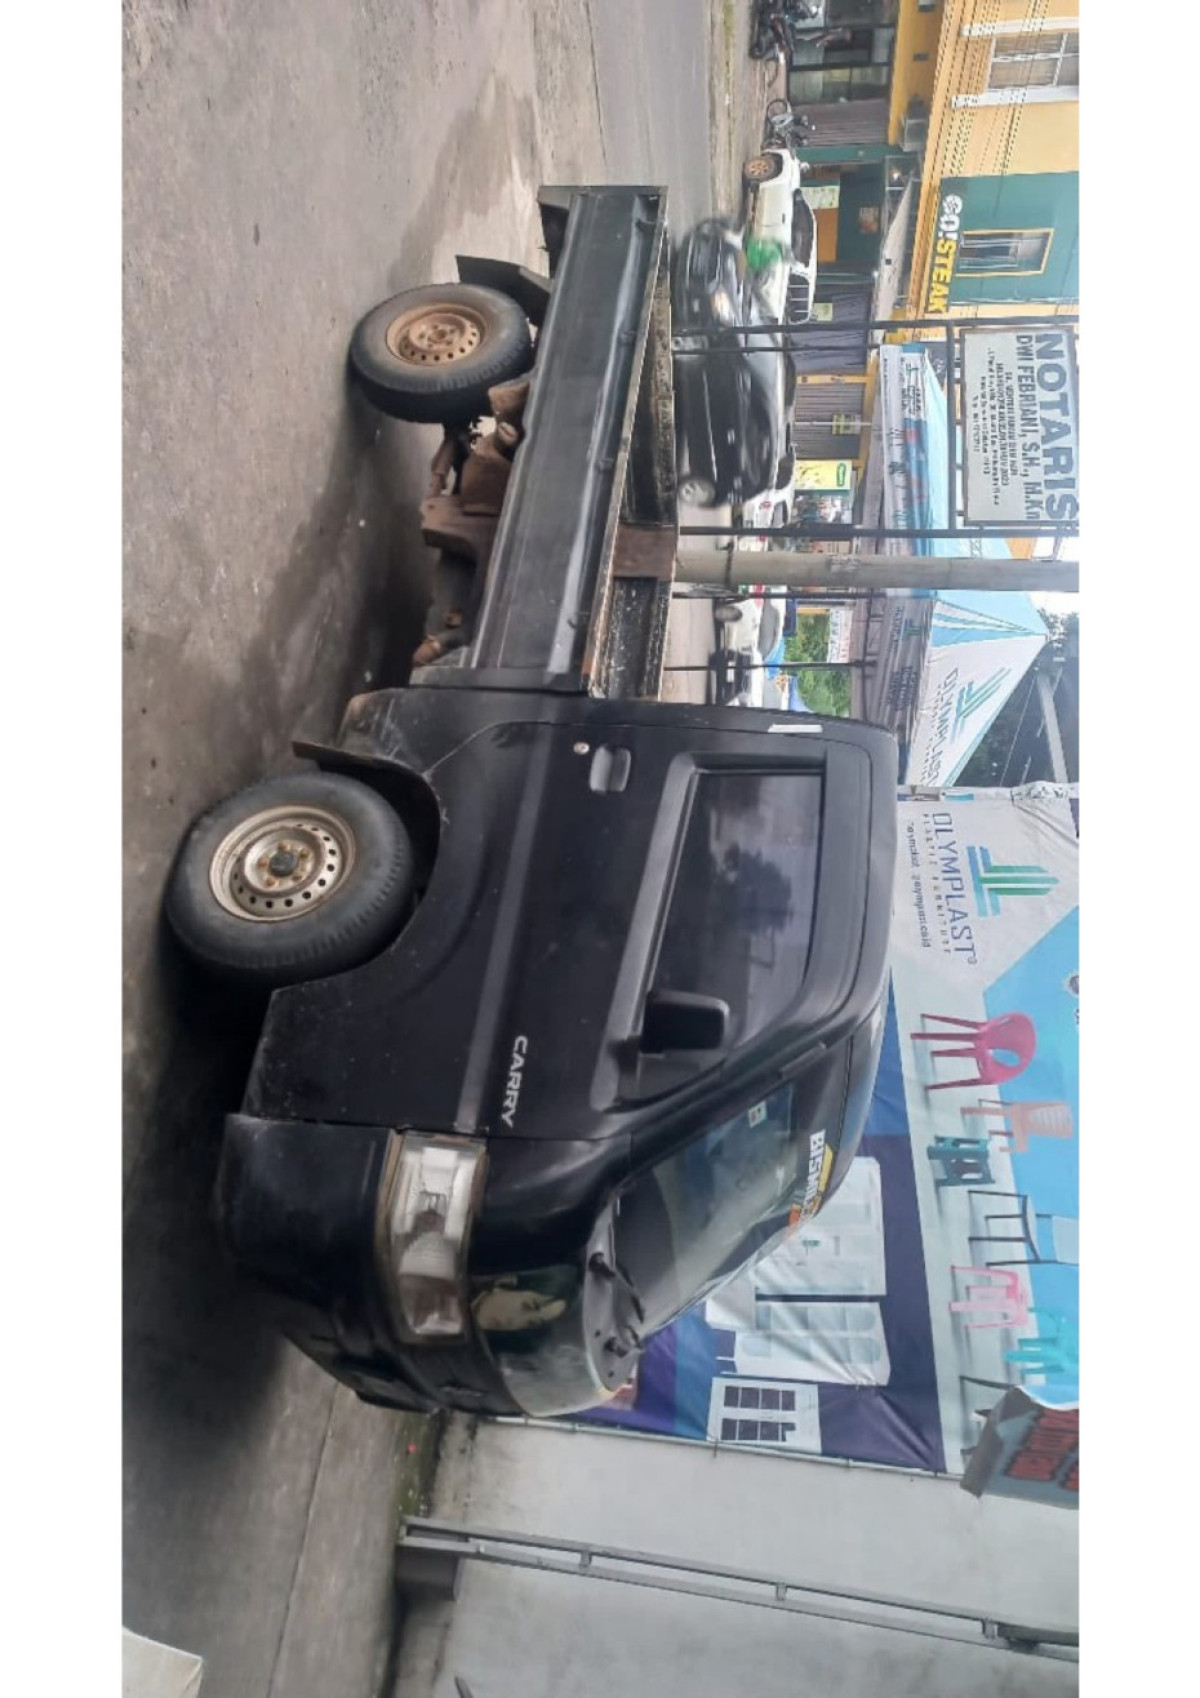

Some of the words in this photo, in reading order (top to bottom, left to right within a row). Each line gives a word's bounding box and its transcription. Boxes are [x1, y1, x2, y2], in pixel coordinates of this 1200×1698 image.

[1016, 335, 1034, 360] DWI
[1017, 366, 1038, 438] FEBRIANI,
[1035, 333, 1076, 520] NOTARIS
[932, 813, 976, 958] OLYMPLAST
[501, 1035, 528, 1127] CARRY
